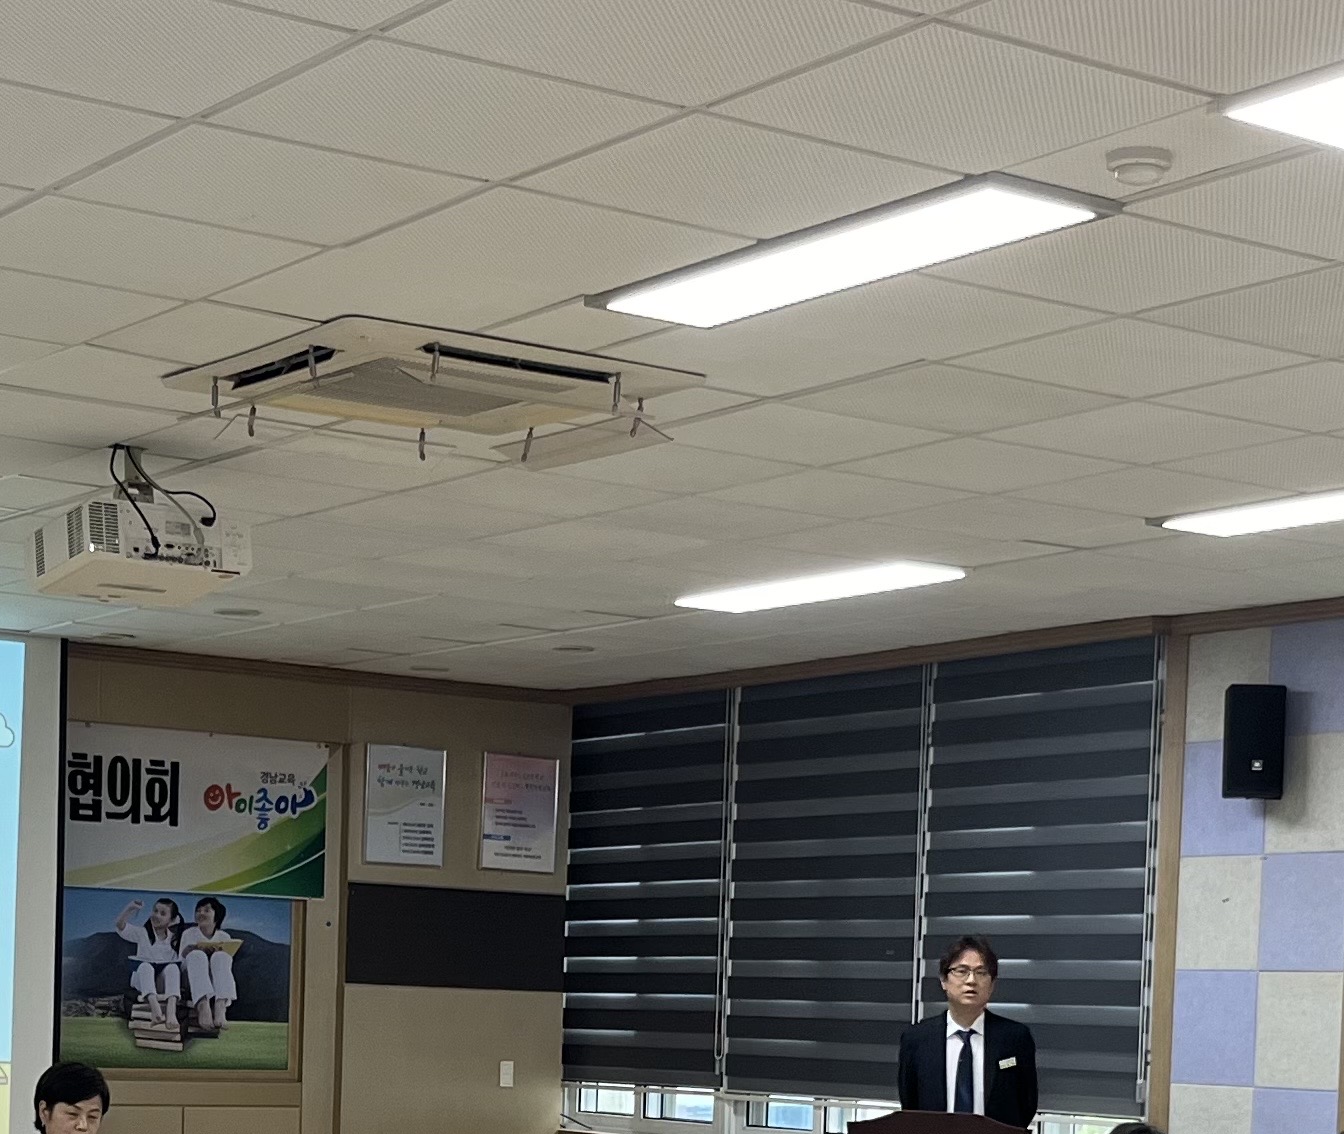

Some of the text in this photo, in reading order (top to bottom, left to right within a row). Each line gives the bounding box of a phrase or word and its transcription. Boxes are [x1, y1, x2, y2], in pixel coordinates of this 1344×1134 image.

[67, 752, 180, 827] 협의회
[260, 771, 296, 786] 경남교육
[203, 783, 315, 831] 아이좋아
